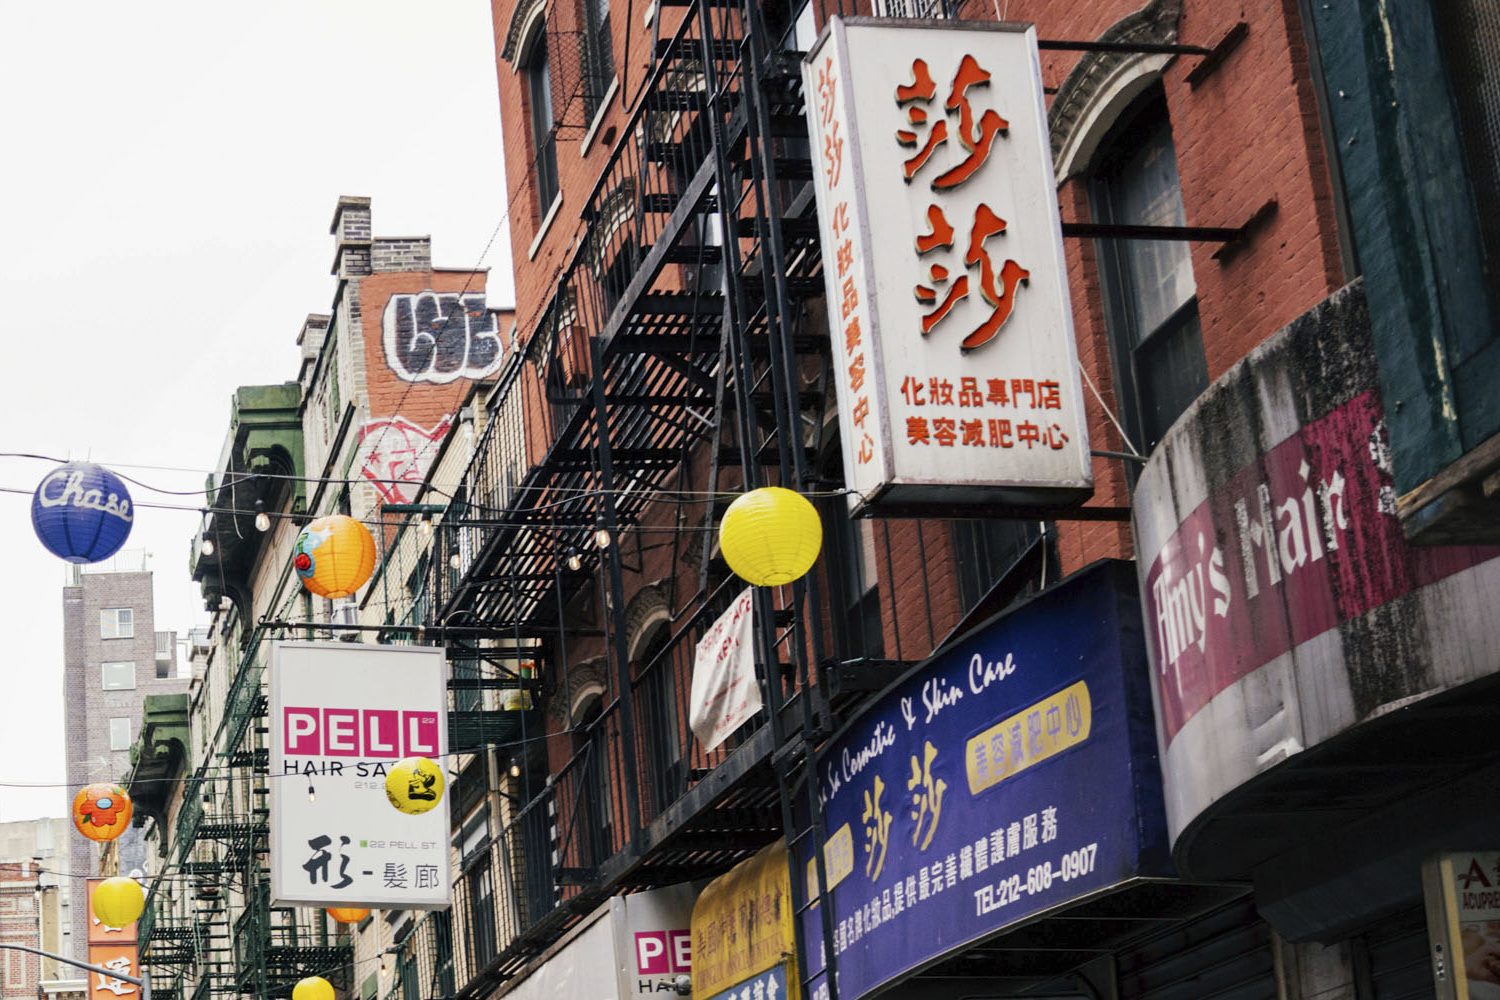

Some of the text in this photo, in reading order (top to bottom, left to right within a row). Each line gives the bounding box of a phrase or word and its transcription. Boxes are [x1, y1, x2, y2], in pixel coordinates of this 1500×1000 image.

[896, 54, 1030, 354] 莎莎
[900, 375, 1062, 410] 化妝品專門店
[905, 416, 1070, 450] 美容減肥中心
[40, 470, 133, 522] Chase
[1152, 531, 1232, 700] Amy's
[287, 711, 434, 755] PELL
[842, 721, 896, 783] Cosmetic
[900, 697, 917, 731] &
[922, 677, 964, 724] Skin
[969, 653, 1017, 695] Care
[283, 760, 344, 777] HAIR
[862, 741, 947, 883] 莎莎
